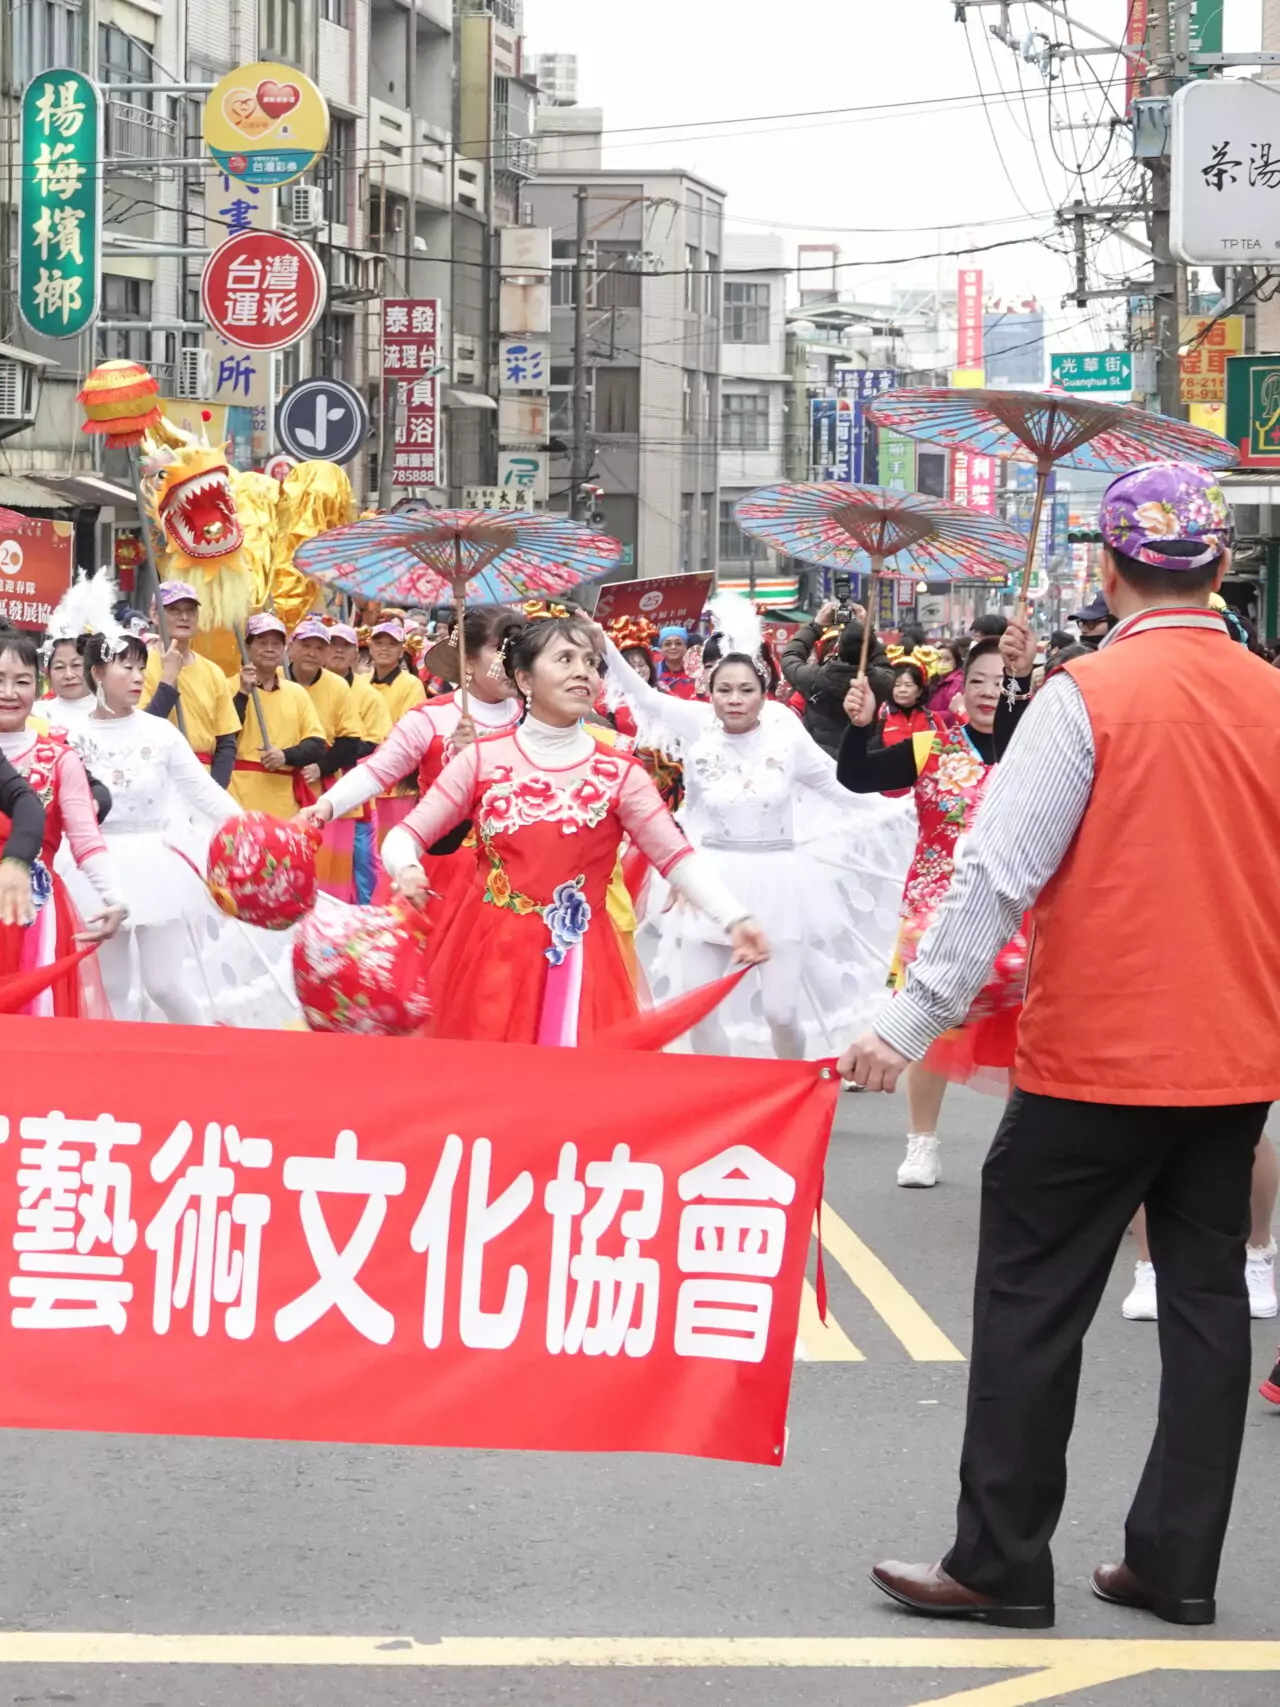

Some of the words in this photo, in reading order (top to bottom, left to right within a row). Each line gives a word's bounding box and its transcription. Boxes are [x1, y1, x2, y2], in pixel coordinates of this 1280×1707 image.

[31, 81, 87, 325] 楊梅檳榔
[1241, 239, 1262, 249] TEA
[227, 254, 300, 290] 台灣
[223, 292, 298, 327] 運彩
[385, 306, 435, 333] 泰發
[384, 344, 435, 369] 流理台
[1061, 356, 1121, 373] 光華街
